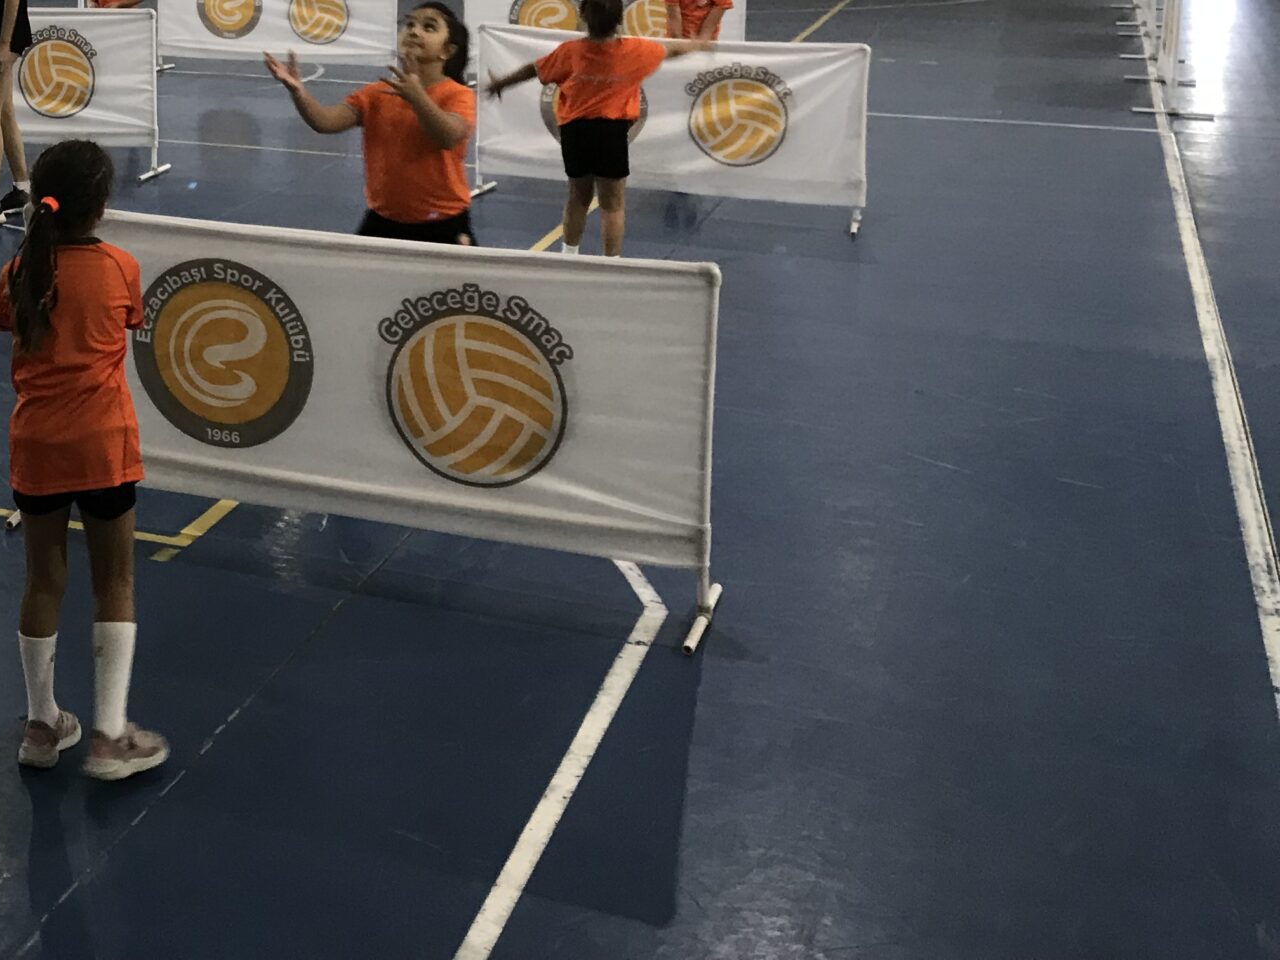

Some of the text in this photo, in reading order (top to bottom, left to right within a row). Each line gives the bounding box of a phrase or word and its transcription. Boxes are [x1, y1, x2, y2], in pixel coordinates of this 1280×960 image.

[31, 25, 65, 43] eceğe
[136, 263, 310, 363] Eczacıbaşı Spor Kulübü
[379, 283, 573, 365] Geleceğe Smaç
[206, 428, 241, 444] 1966
